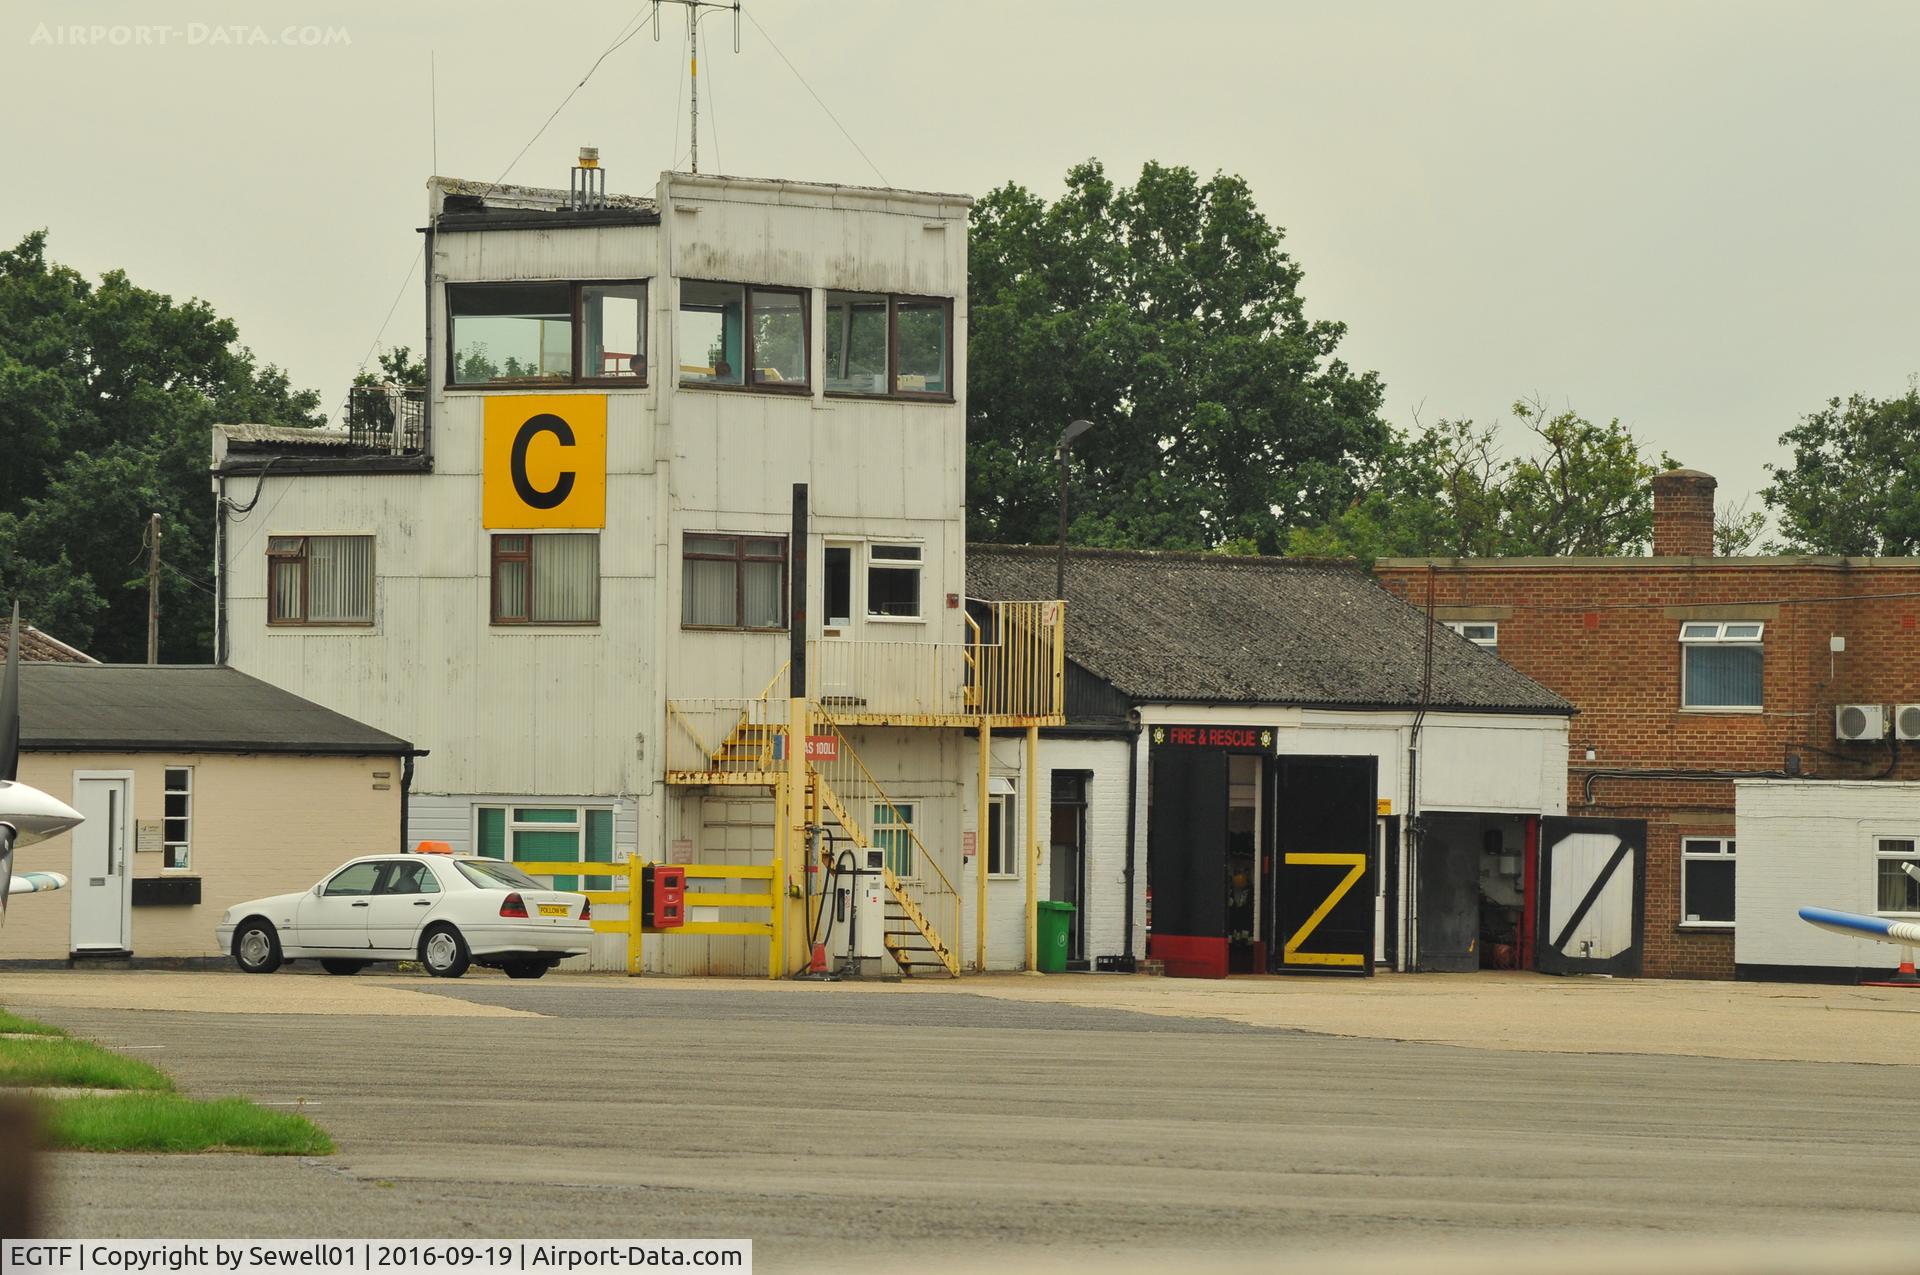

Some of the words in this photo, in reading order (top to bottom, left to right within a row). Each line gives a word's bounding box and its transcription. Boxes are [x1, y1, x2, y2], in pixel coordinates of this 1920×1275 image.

[511, 413, 576, 509] C
[1170, 728, 1196, 744] FIRE
[1199, 729, 1207, 745] &
[1210, 730, 1255, 746] RESCUE
[540, 906, 560, 914] FOLLOW
